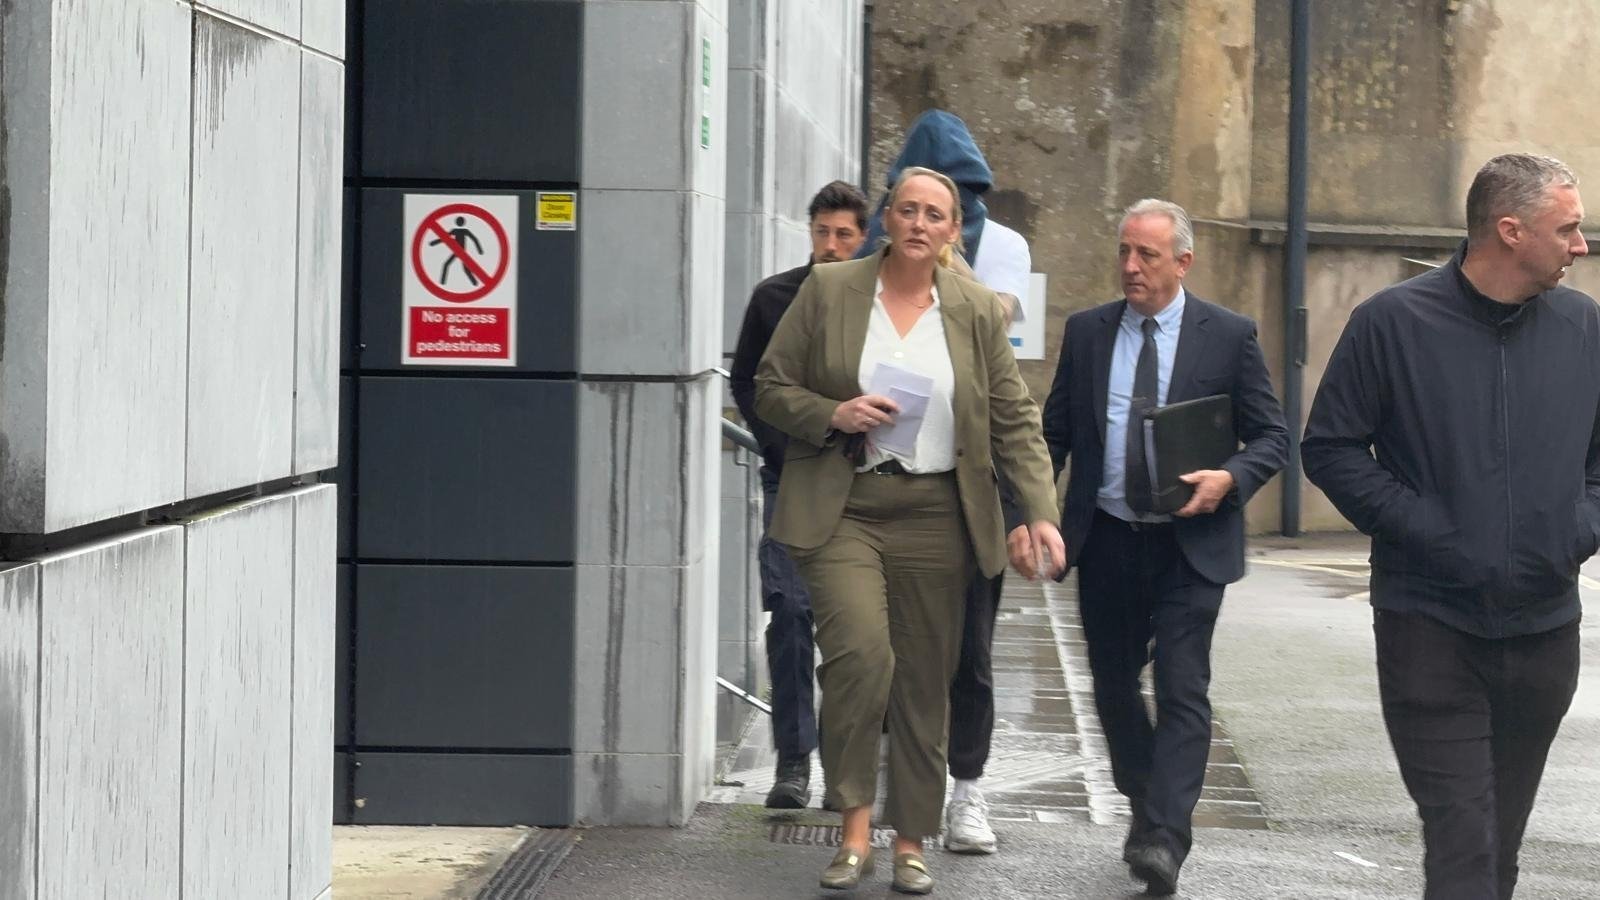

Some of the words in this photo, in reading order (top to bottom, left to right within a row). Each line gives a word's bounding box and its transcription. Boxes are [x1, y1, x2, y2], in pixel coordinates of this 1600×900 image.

[421, 310, 443, 323] No
[445, 313, 497, 324] access
[448, 325, 471, 337] for
[416, 340, 502, 354] pedestrians
